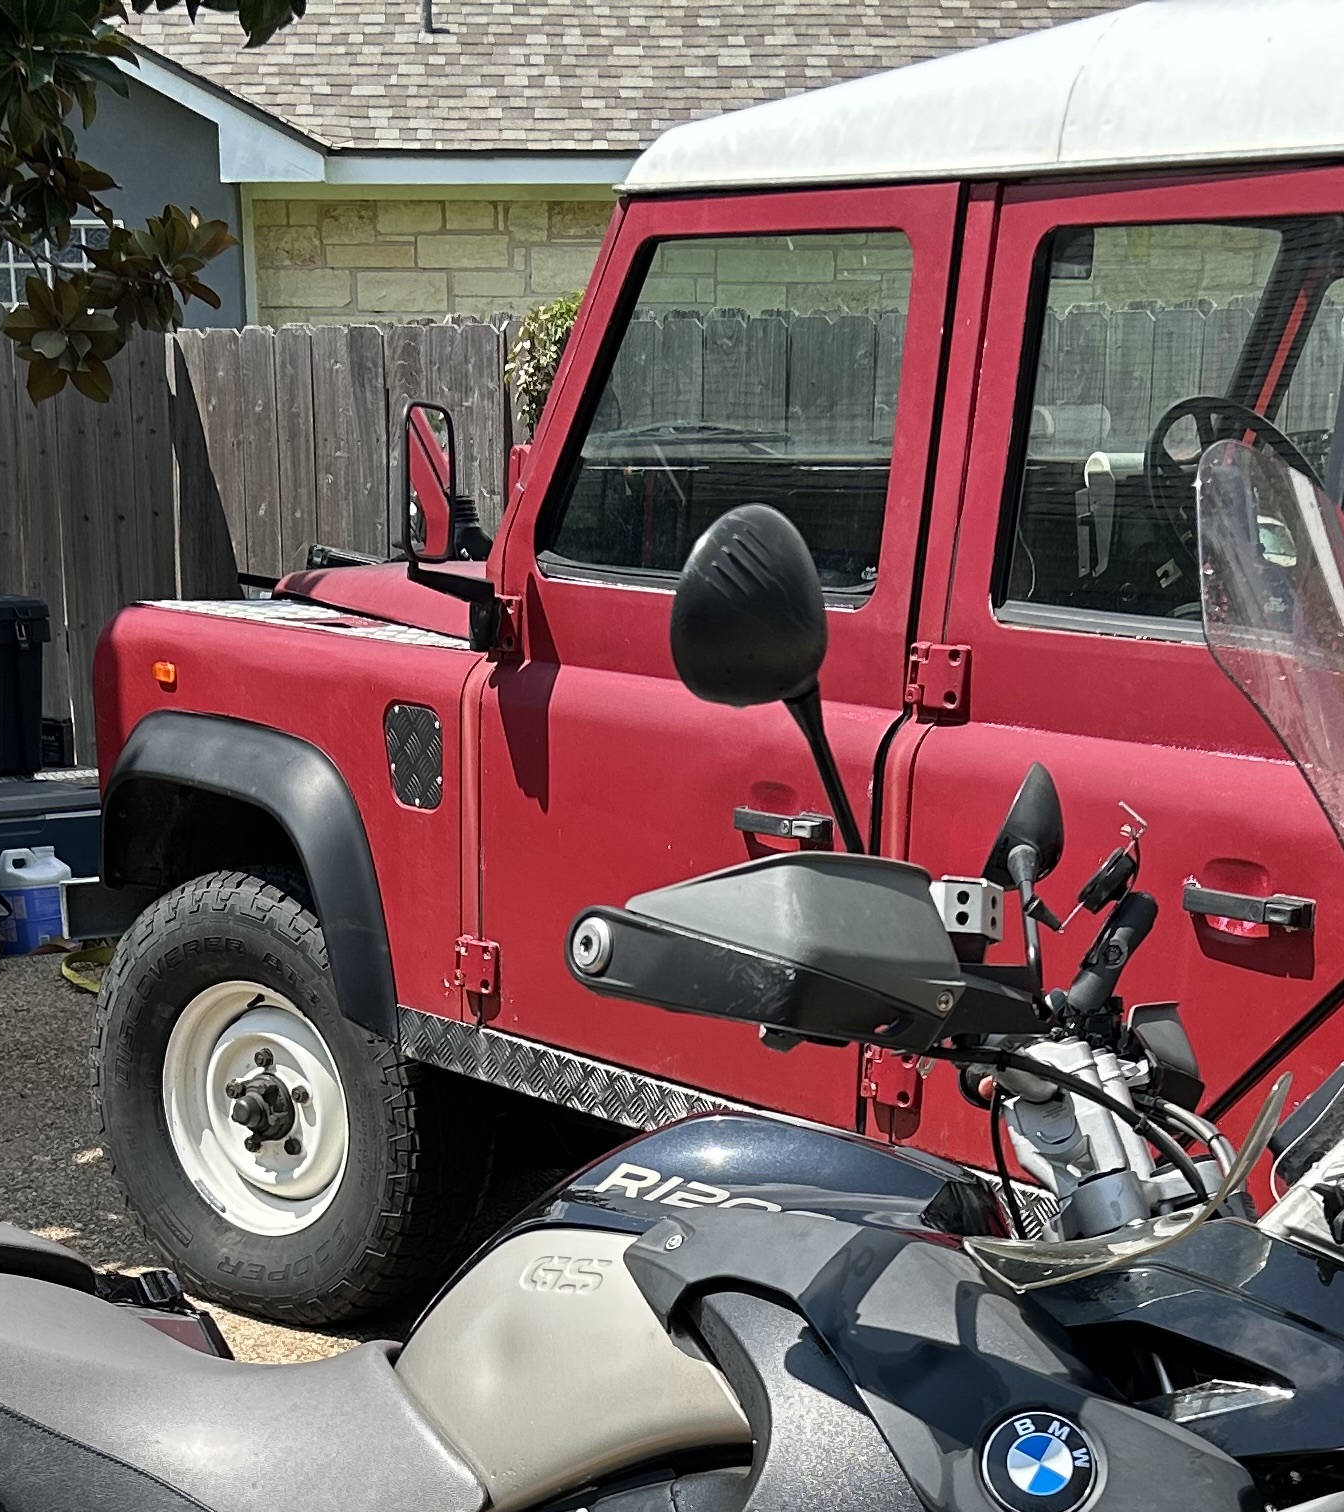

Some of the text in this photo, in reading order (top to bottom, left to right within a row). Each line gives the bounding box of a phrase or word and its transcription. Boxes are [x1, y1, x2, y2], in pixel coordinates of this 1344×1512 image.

[115, 935, 246, 1088] DISCOVERER
[593, 1162, 834, 1222] R12
[216, 1218, 349, 1284] COOPER
[519, 1255, 612, 1294] GS
[1013, 1418, 1090, 1468] BMW
